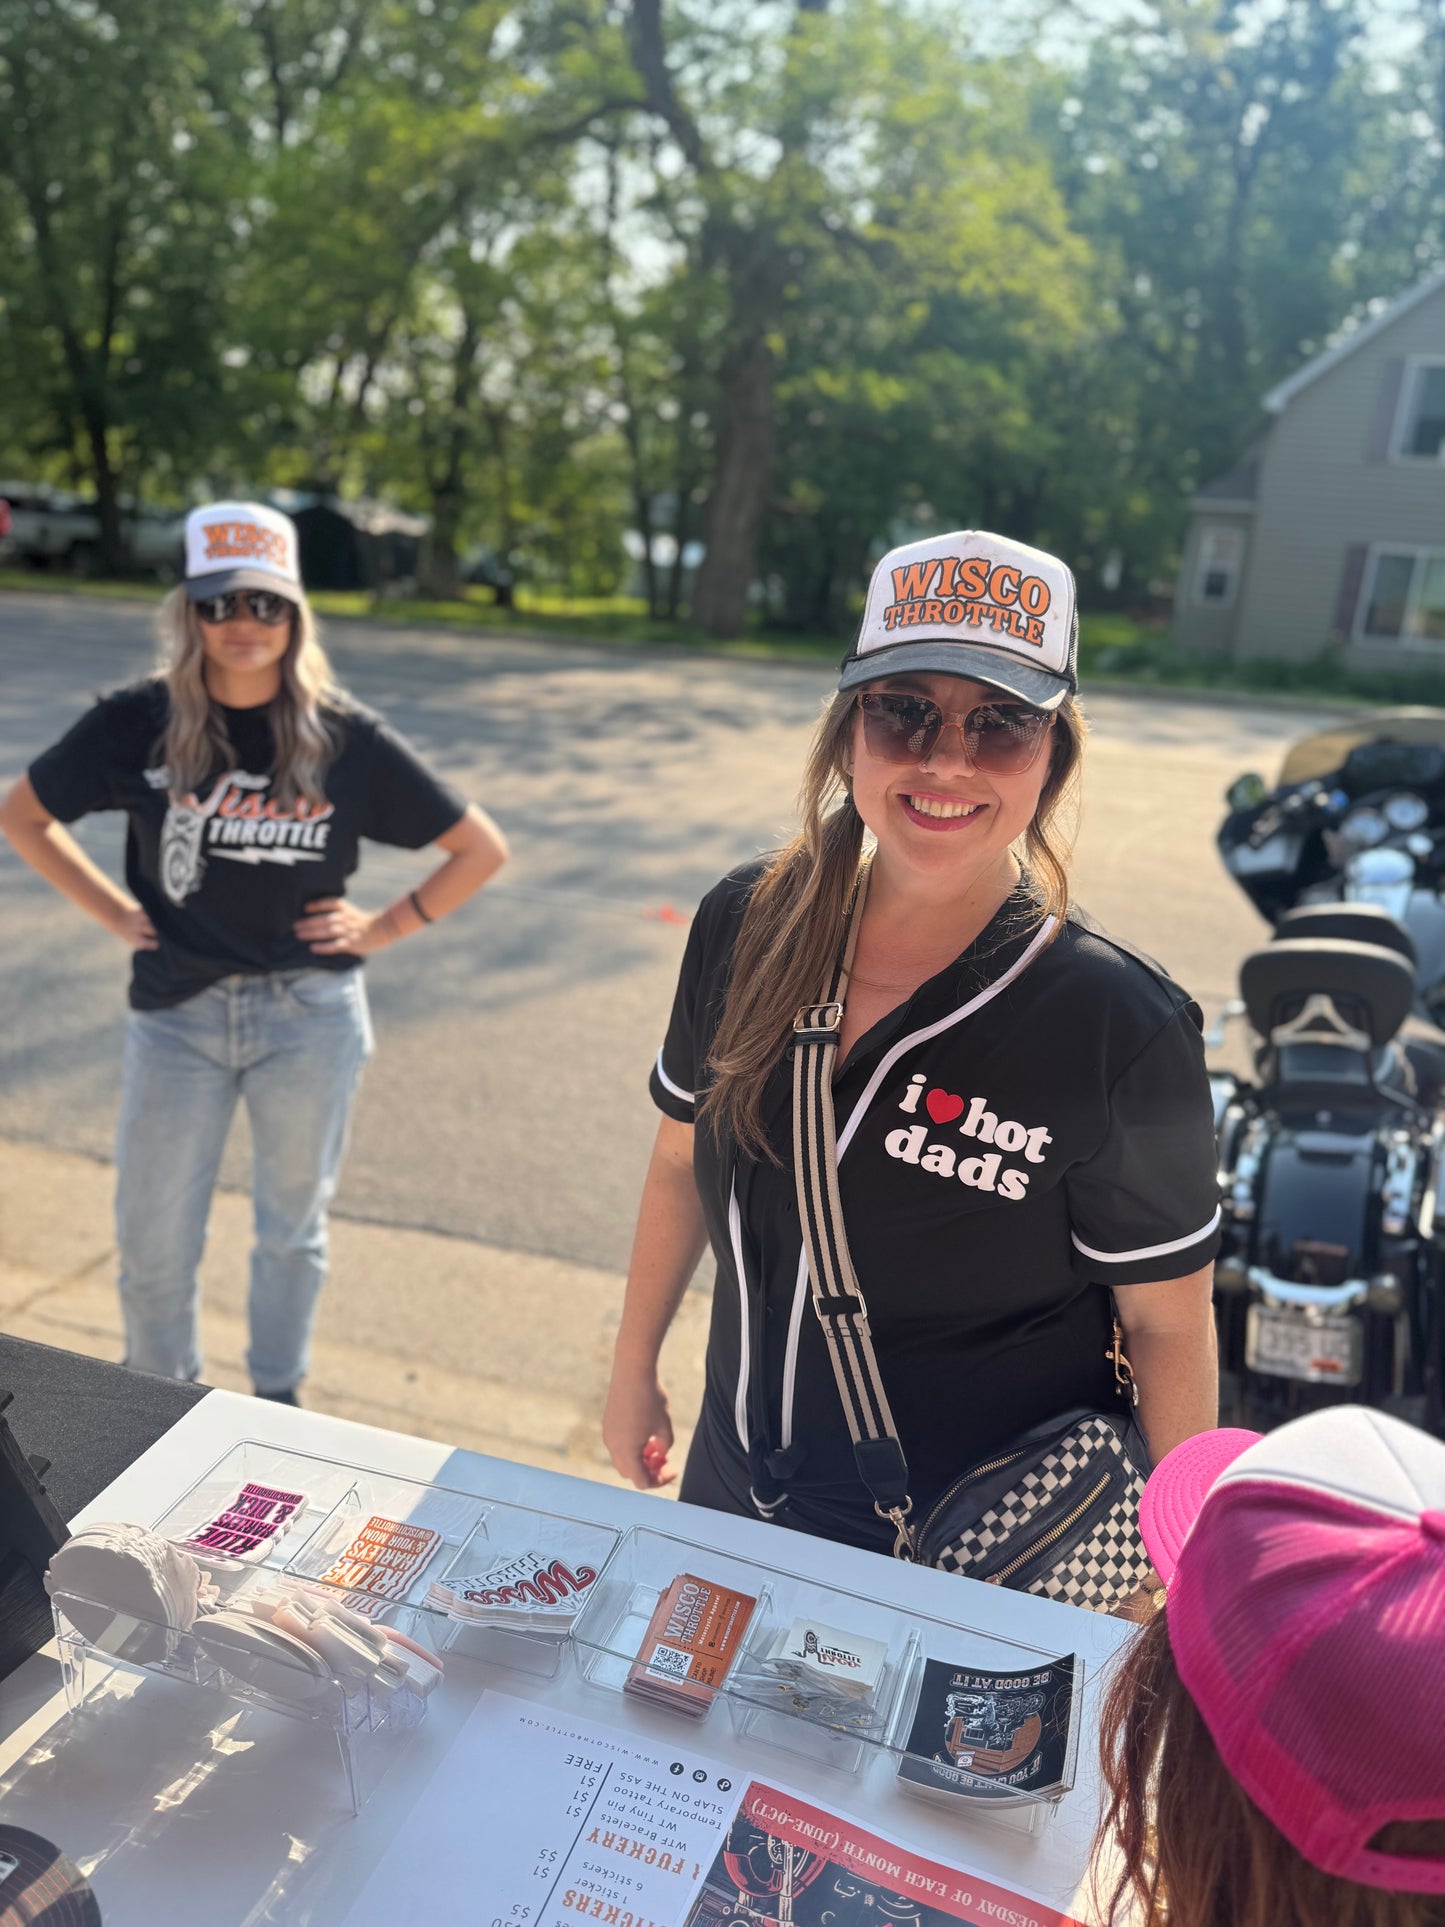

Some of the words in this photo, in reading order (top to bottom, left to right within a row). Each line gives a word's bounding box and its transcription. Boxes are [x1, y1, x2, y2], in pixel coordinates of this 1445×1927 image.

[891, 556, 1051, 616] WISCO
[883, 599, 1045, 647] THROTTLE
[207, 817, 331, 849] THROTTLE
[898, 1073, 927, 1114] i
[959, 1097, 1053, 1164] hot
[884, 1125, 1030, 1201] dads
[227, 1493, 278, 1520] DICK
[272, 1504, 295, 1524] &
[212, 1513, 279, 1539] HARLEYS
[360, 1527, 390, 1544] MOM
[369, 1518, 433, 1540] @WISCOTHROTTLE
[193, 1527, 265, 1556] RIDE
[388, 1534, 415, 1552] YOUR
[415, 1541, 427, 1553] &
[346, 1540, 417, 1570] HARLEYS
[322, 1557, 404, 1596] RIDE
[441, 1552, 547, 1590] THROTTLE
[464, 1560, 599, 1605] Wisco
[664, 1582, 700, 1638] WISCO
[681, 1587, 712, 1644] THROTTLE
[698, 1616, 713, 1646] Motorcycle
[710, 1594, 721, 1615] Apparel
[952, 1674, 969, 1687] IT
[971, 1677, 992, 1689] AT
[994, 1678, 1030, 1690] GOOD
[1032, 1671, 1051, 1687] BE
[564, 1753, 603, 1773] FREE
[580, 1775, 596, 1788] $1
[619, 1772, 642, 1785] ASS
[646, 1781, 666, 1795] THE
[573, 1790, 589, 1803] $1
[613, 1786, 651, 1806] Tattoo
[672, 1791, 690, 1803] ON
[565, 1805, 582, 1818] $1
[608, 1800, 625, 1813] Pin
[629, 1807, 654, 1826] Tiny
[656, 1799, 722, 1830] Temporary
[694, 1799, 724, 1815] SLAP
[600, 1813, 657, 1841] Bracelets
[658, 1820, 677, 1832] WT
[751, 1797, 840, 1849] (JUNE-OCT)
[585, 1826, 686, 1876] FUCKERY
[661, 1838, 687, 1851] WTF
[538, 1848, 558, 1862] $5
[842, 1841, 902, 1879] MONTH
[533, 1865, 550, 1879] $1
[582, 1861, 633, 1887] stickers
[574, 1877, 619, 1899] sticker
[635, 1882, 644, 1892] 6
[906, 1869, 947, 1897] EACH
[621, 1896, 628, 1905] 1
[952, 1887, 973, 1907] OF
[511, 1903, 531, 1919] $5
[562, 1889, 660, 1927] ICKERS
[977, 1896, 1046, 1927] UESDAY
